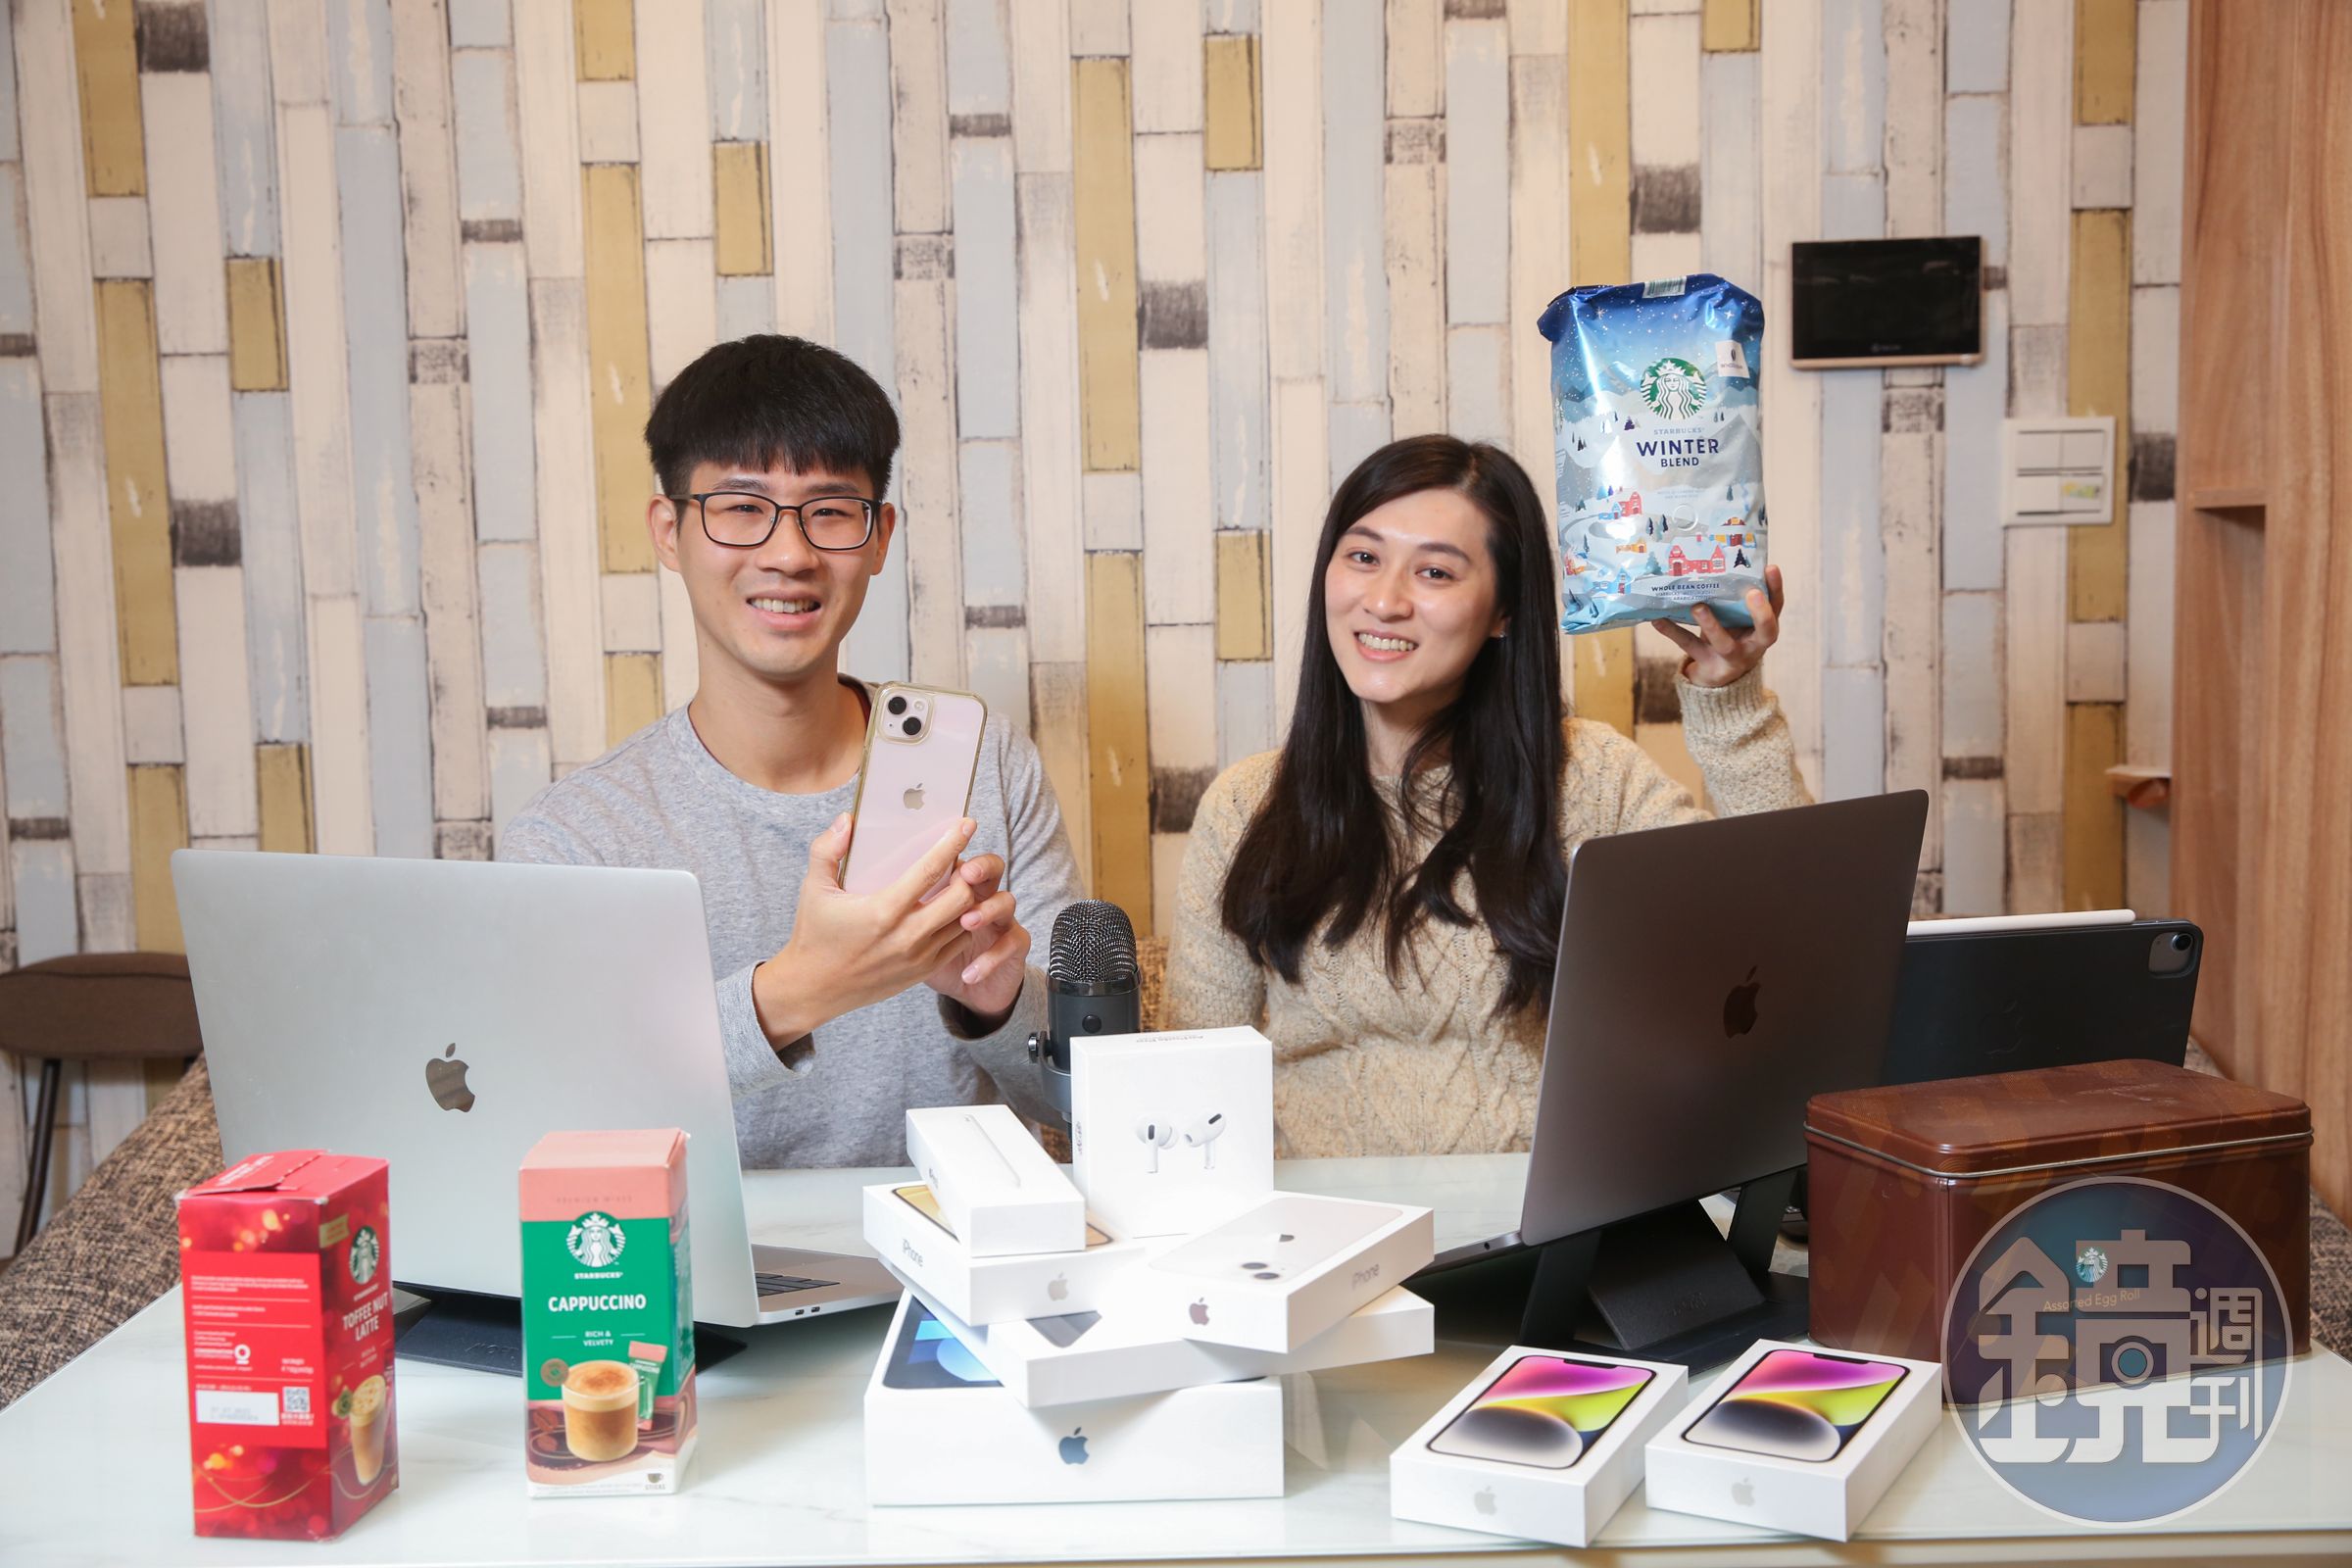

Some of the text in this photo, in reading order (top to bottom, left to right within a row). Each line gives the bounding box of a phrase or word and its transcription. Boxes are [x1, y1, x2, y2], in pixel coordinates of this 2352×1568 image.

[1636, 438, 1720, 457] WINTER
[1660, 457, 1700, 467] BLEND
[902, 1238, 924, 1268] iPhone
[548, 1293, 647, 1313] CAPPUCCINO
[2094, 1292, 2118, 1308] Egg
[2119, 1288, 2141, 1302] Roll
[342, 1291, 389, 1331] TOFFEE NUT
[354, 1315, 380, 1342] LATTE
[584, 1330, 604, 1339] RICH
